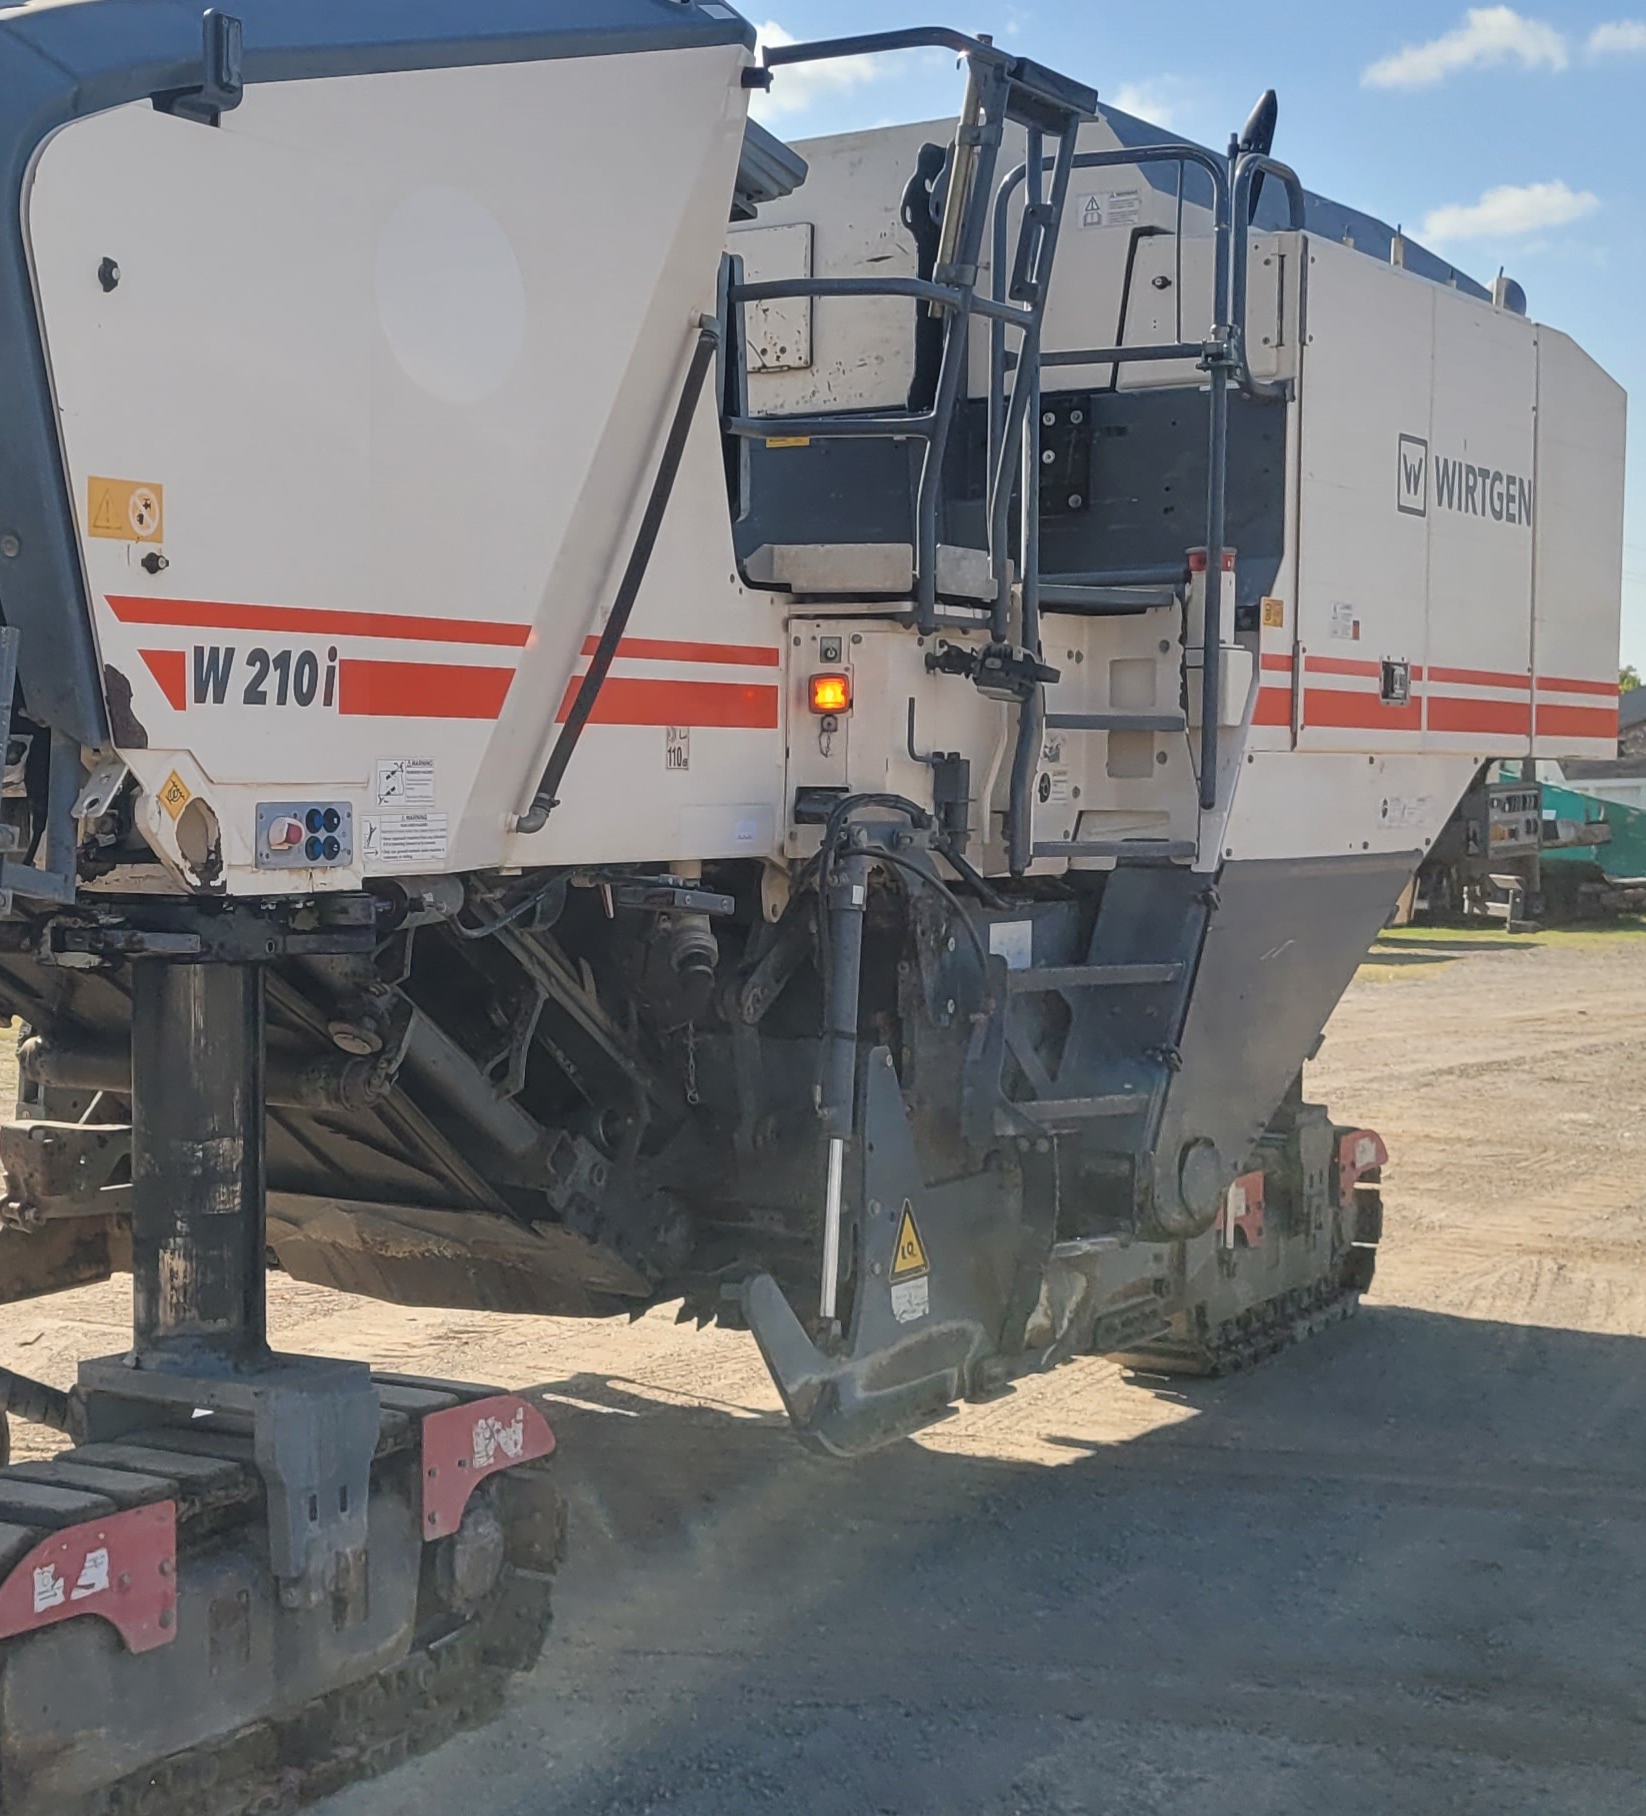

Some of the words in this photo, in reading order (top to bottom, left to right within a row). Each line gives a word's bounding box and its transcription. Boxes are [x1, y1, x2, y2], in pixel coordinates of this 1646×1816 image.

[1403, 453, 1423, 496] W
[1435, 455, 1532, 527] WIRTGEN
[194, 645, 236, 704] W
[242, 645, 338, 707] 210i
[667, 746, 682, 767] 110
